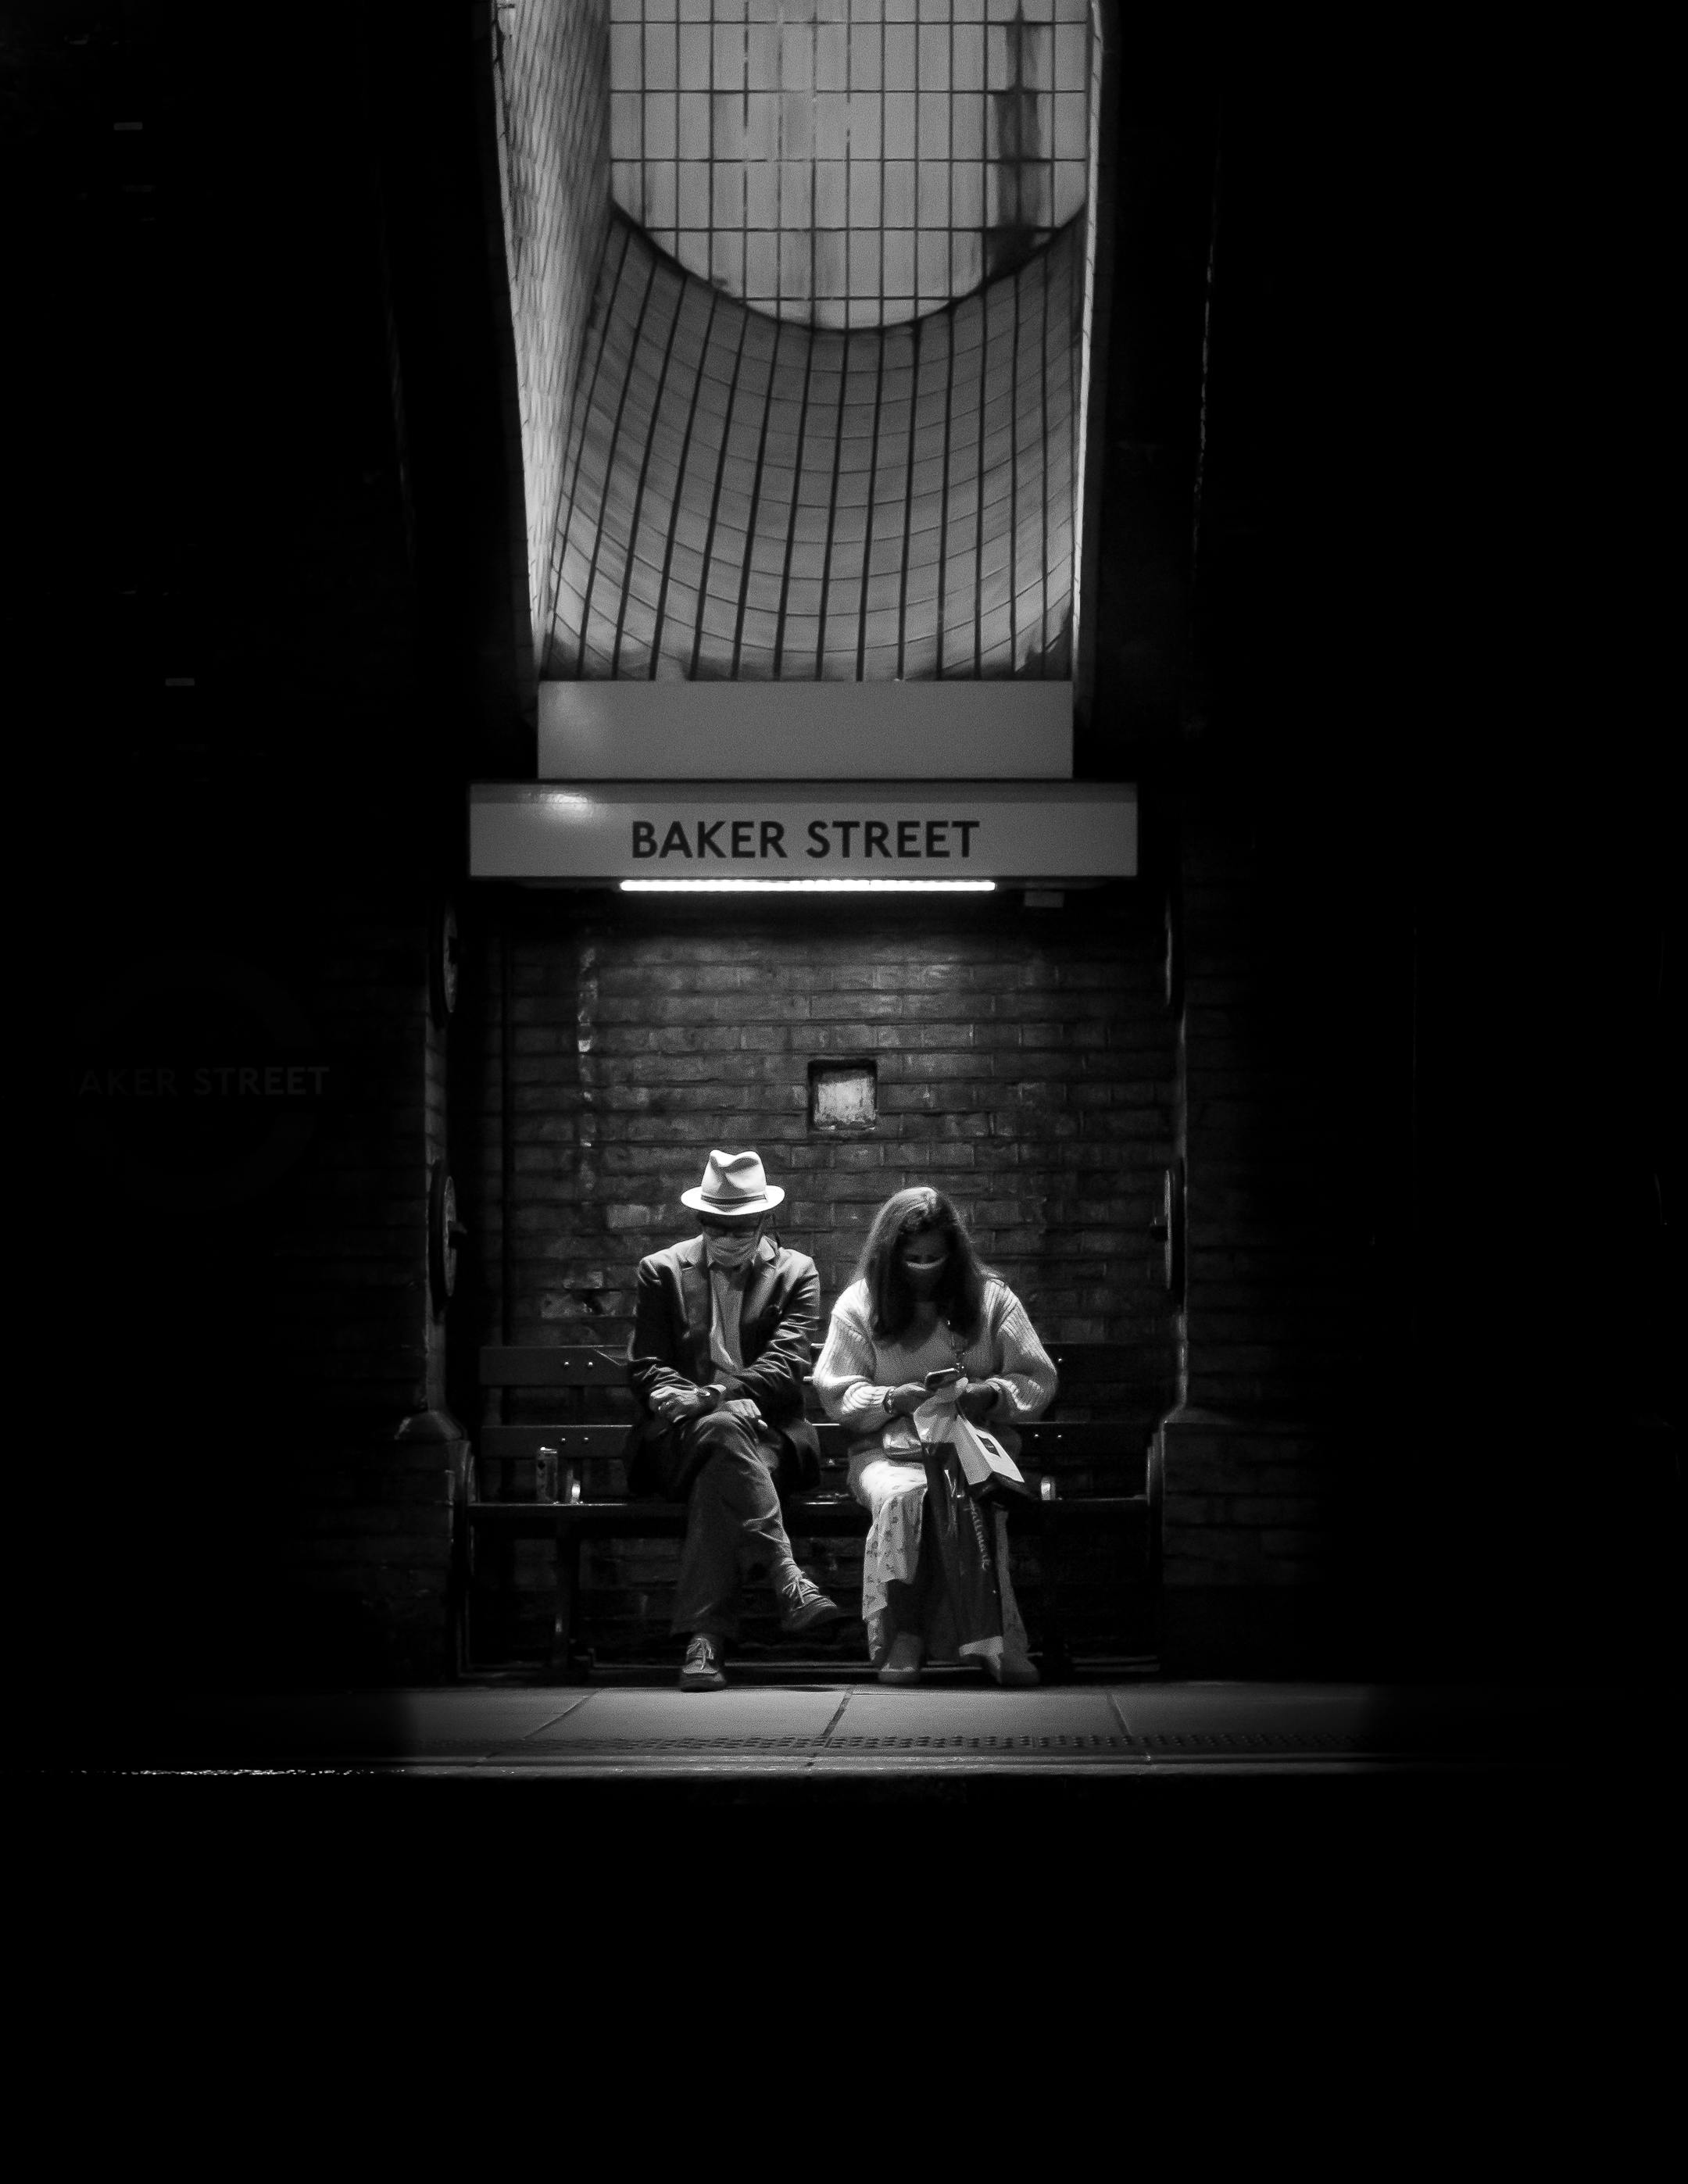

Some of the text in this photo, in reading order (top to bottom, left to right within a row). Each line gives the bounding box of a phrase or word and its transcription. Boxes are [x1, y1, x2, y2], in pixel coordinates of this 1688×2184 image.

[631, 820, 980, 859] BAKER STREET
[73, 1066, 331, 1097] AKER STREET
